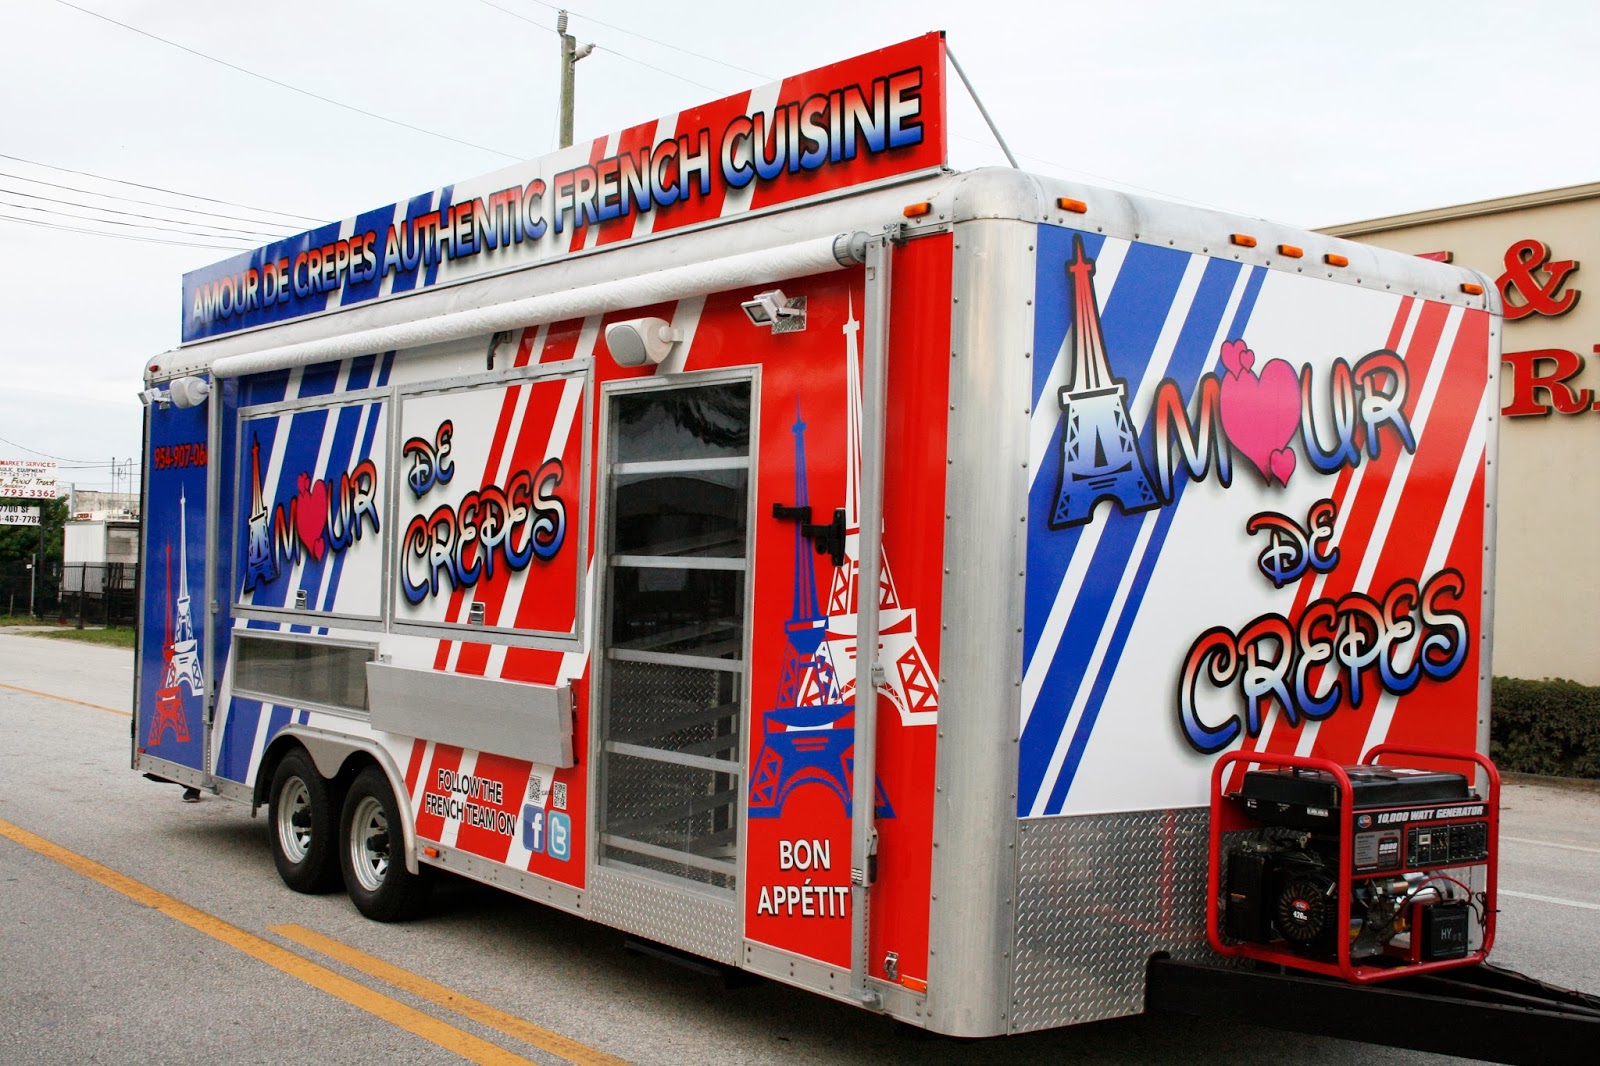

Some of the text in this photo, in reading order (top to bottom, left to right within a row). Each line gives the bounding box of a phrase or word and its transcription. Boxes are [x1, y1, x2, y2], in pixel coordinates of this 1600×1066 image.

[192, 66, 923, 327] AMOUR DE CREPES AUTHENTIC FRENCH CUISINE
[1495, 239, 1580, 320] &
[1502, 345, 1600, 416] R
[154, 442, 208, 470] 954-907-06
[404, 419, 454, 499] DE
[11, 477, 32, 485] Food
[0, 515, 40, 524] -467-7787
[402, 457, 565, 605] CREPES
[1247, 498, 1340, 588] DE
[1178, 567, 1470, 754] CREPES
[438, 768, 503, 805] FOLLOW THE
[425, 793, 517, 836] FRENCH TEAM ON
[1410, 809, 1435, 821] WATT
[1436, 806, 1484, 819] GENERATOR
[779, 839, 831, 870] BON
[757, 878, 851, 917] APPÉTIT
